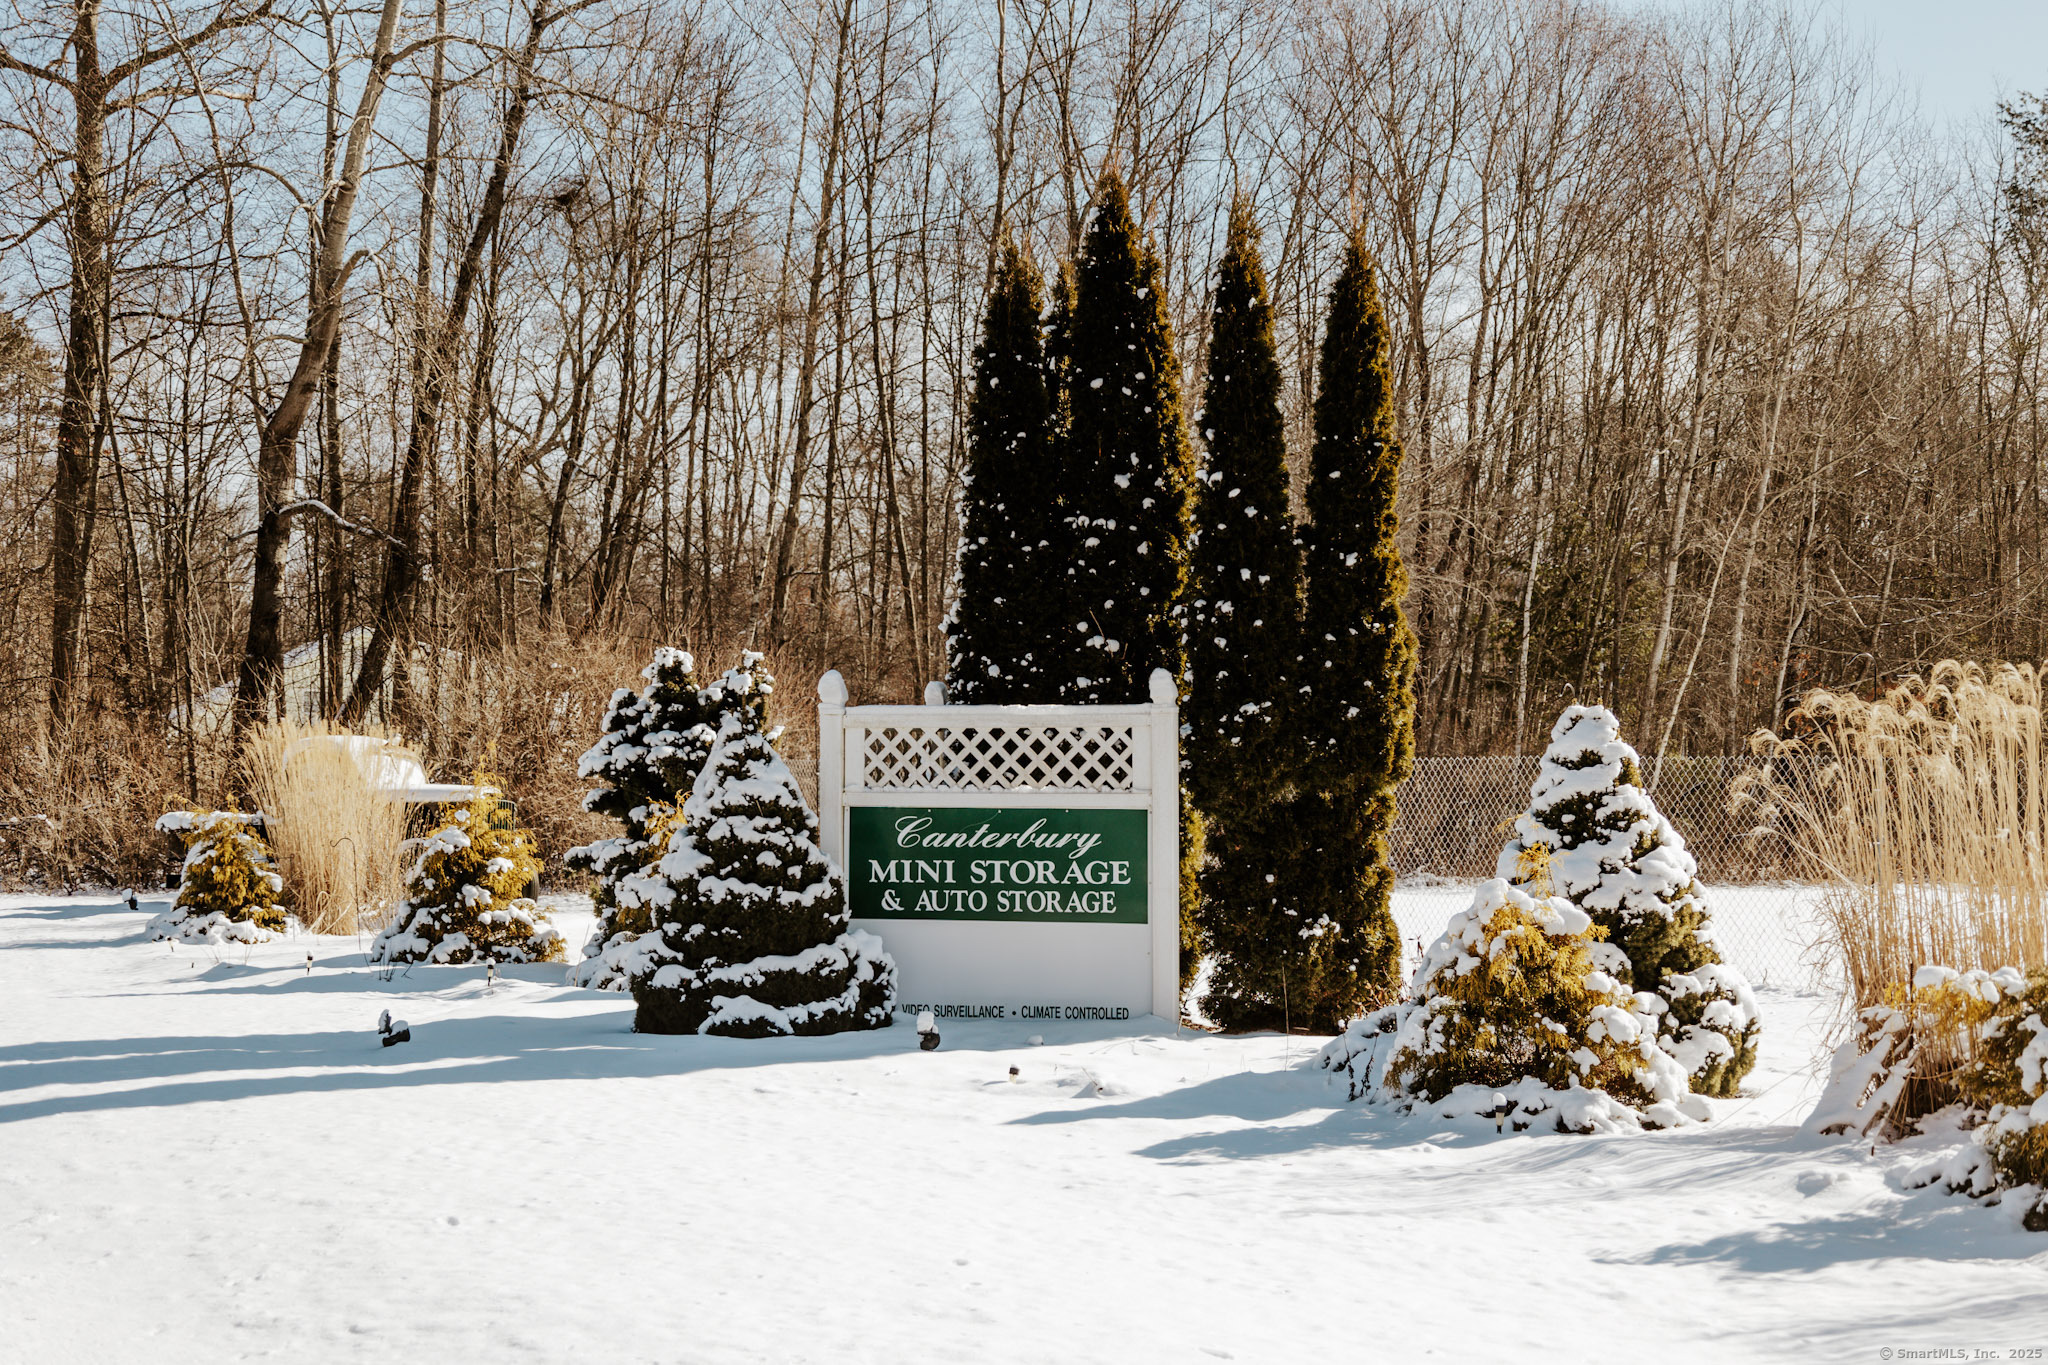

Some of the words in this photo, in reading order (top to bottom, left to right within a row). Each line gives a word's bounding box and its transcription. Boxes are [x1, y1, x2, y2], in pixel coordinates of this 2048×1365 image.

[895, 816, 1102, 859] Canterbury
[868, 859, 957, 884] MINI
[970, 860, 1132, 885] STORAGE
[881, 889, 904, 911] &
[914, 889, 988, 912] AUTO
[997, 890, 1117, 914] STORAGE
[934, 1005, 1005, 1018] SURVEILLANCE
[1021, 1006, 1061, 1019] CLIMATE
[1065, 1006, 1129, 1020] CONTROLLED
